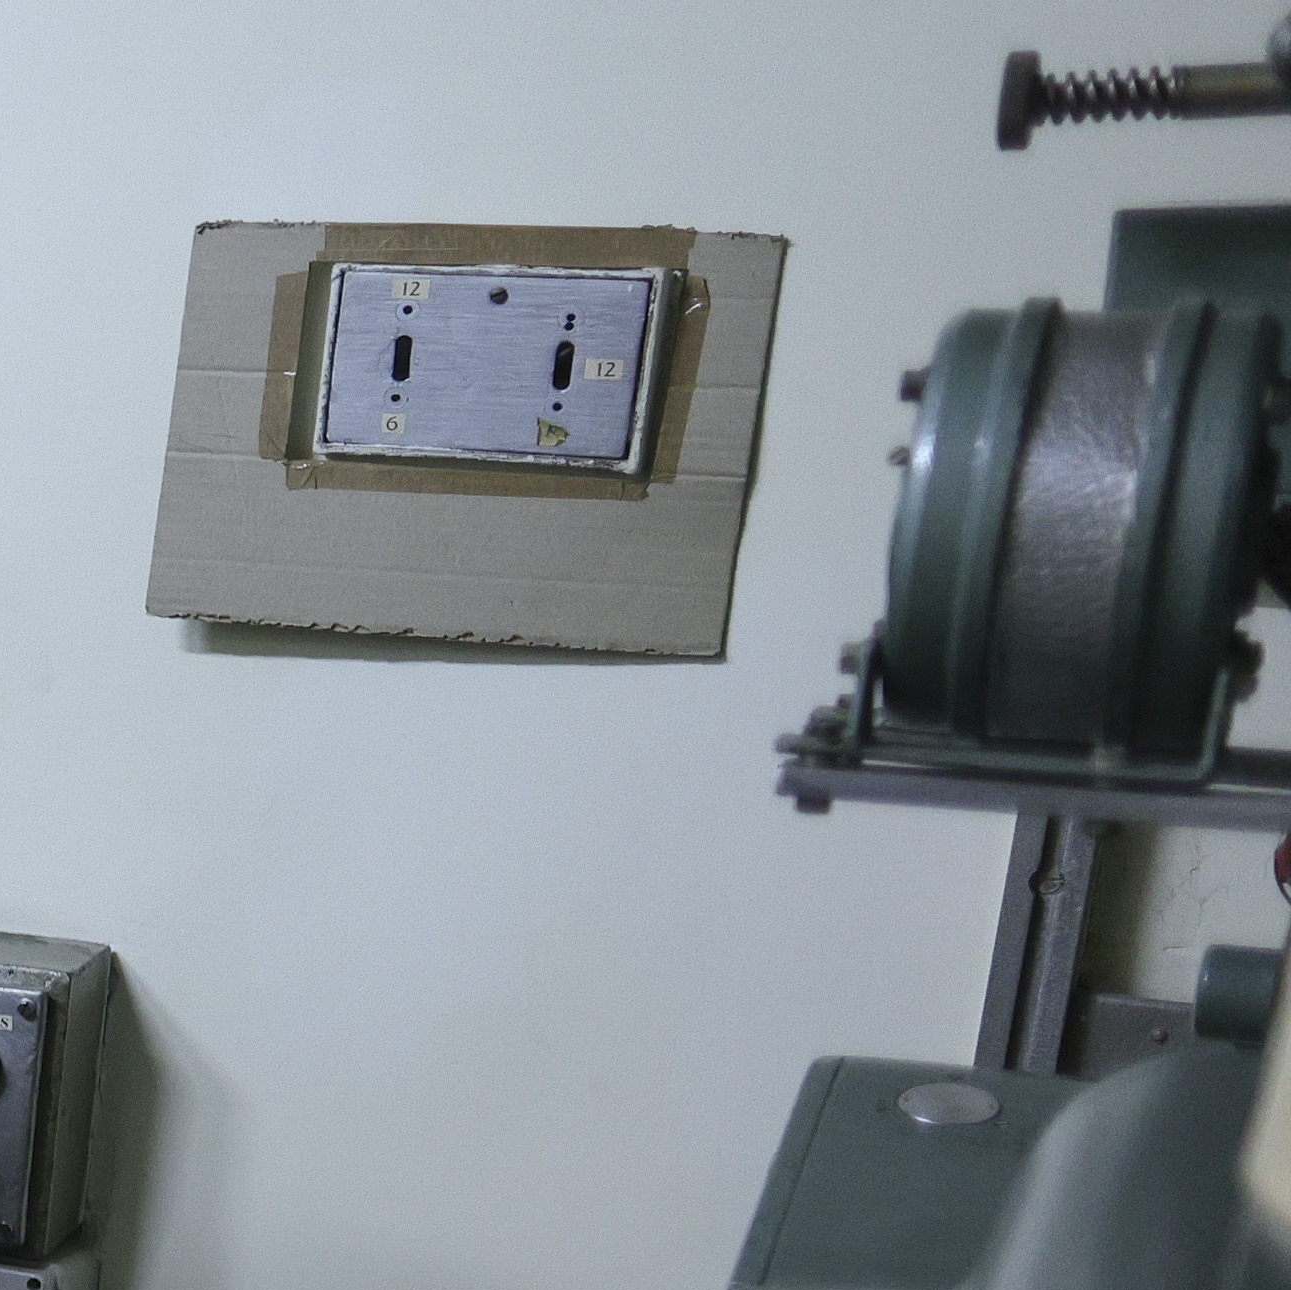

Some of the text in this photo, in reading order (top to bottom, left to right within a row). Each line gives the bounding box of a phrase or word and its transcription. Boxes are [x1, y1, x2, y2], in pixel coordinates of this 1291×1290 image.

[402, 281, 421, 297] 12
[596, 362, 617, 378] 12
[386, 415, 399, 432] 6
